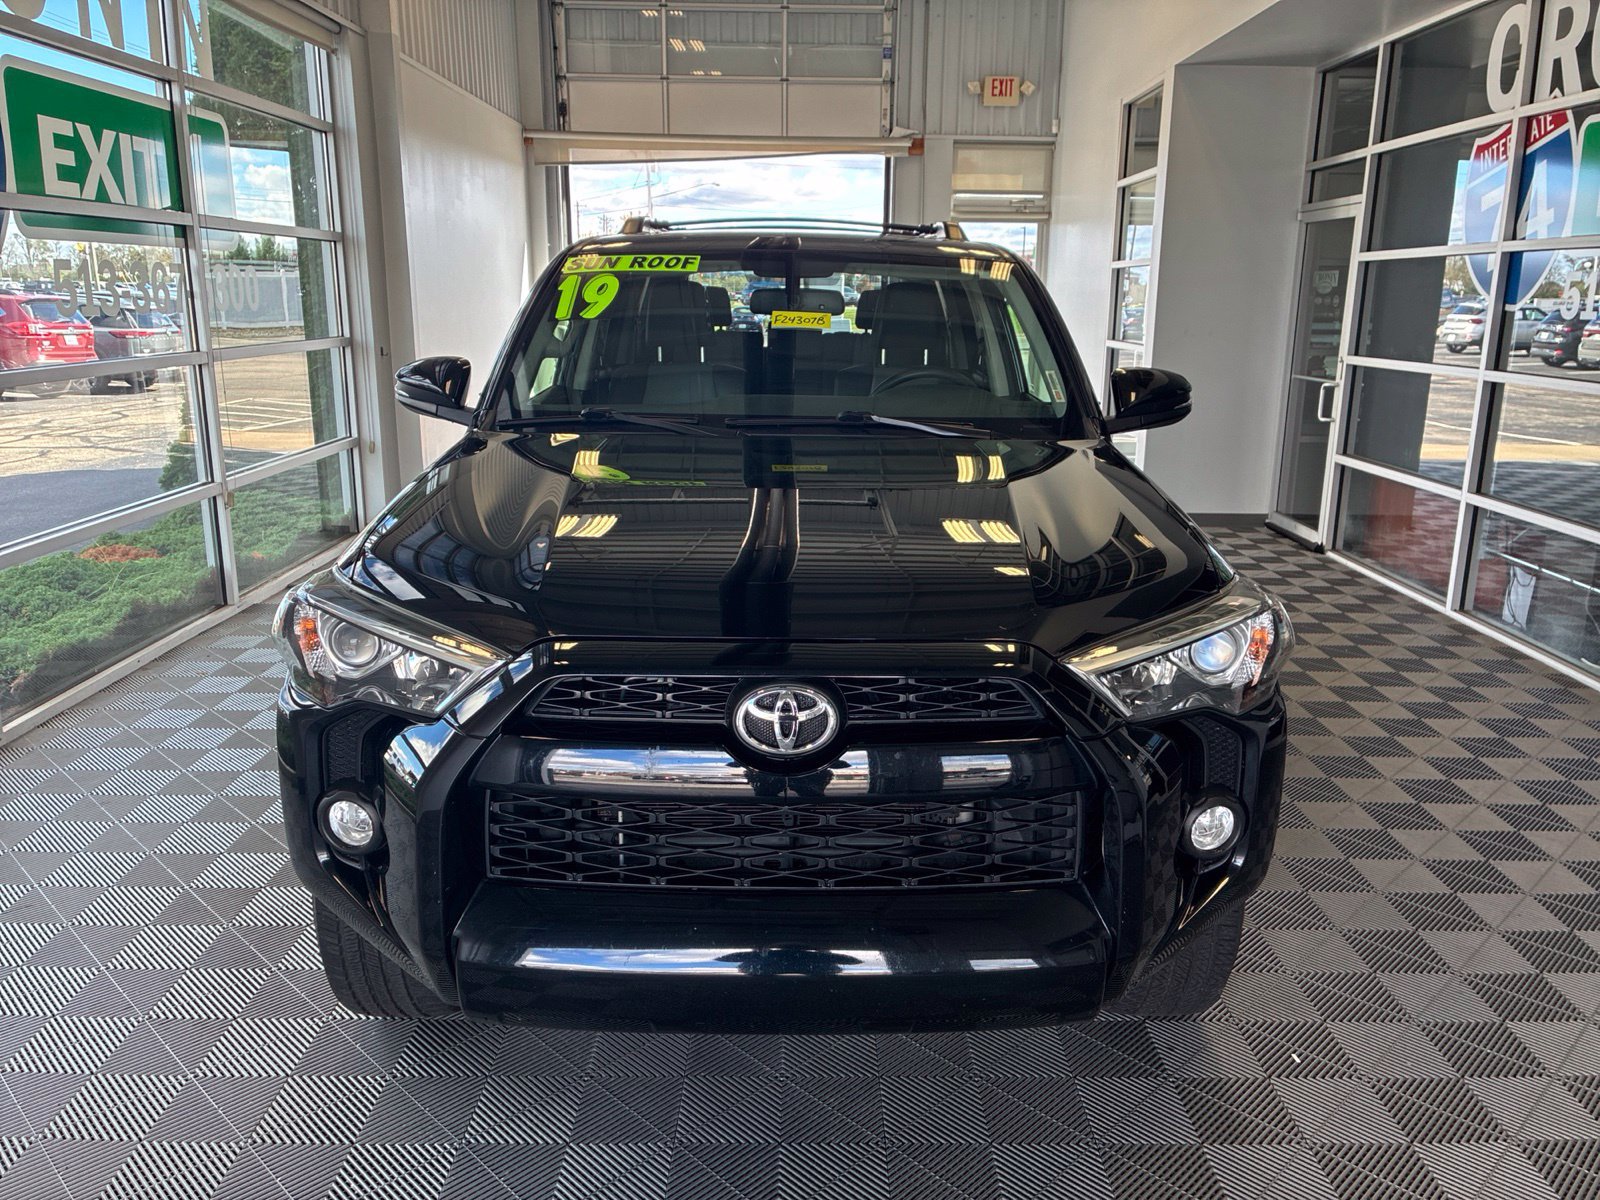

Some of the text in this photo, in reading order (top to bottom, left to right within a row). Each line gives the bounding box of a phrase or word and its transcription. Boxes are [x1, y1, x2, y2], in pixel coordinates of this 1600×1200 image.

[1486, 0, 1600, 113] CR
[991, 78, 1015, 97] EXIT
[37, 114, 171, 210] EXIT
[567, 256, 697, 271] SUN ROOF
[555, 273, 620, 321] 19
